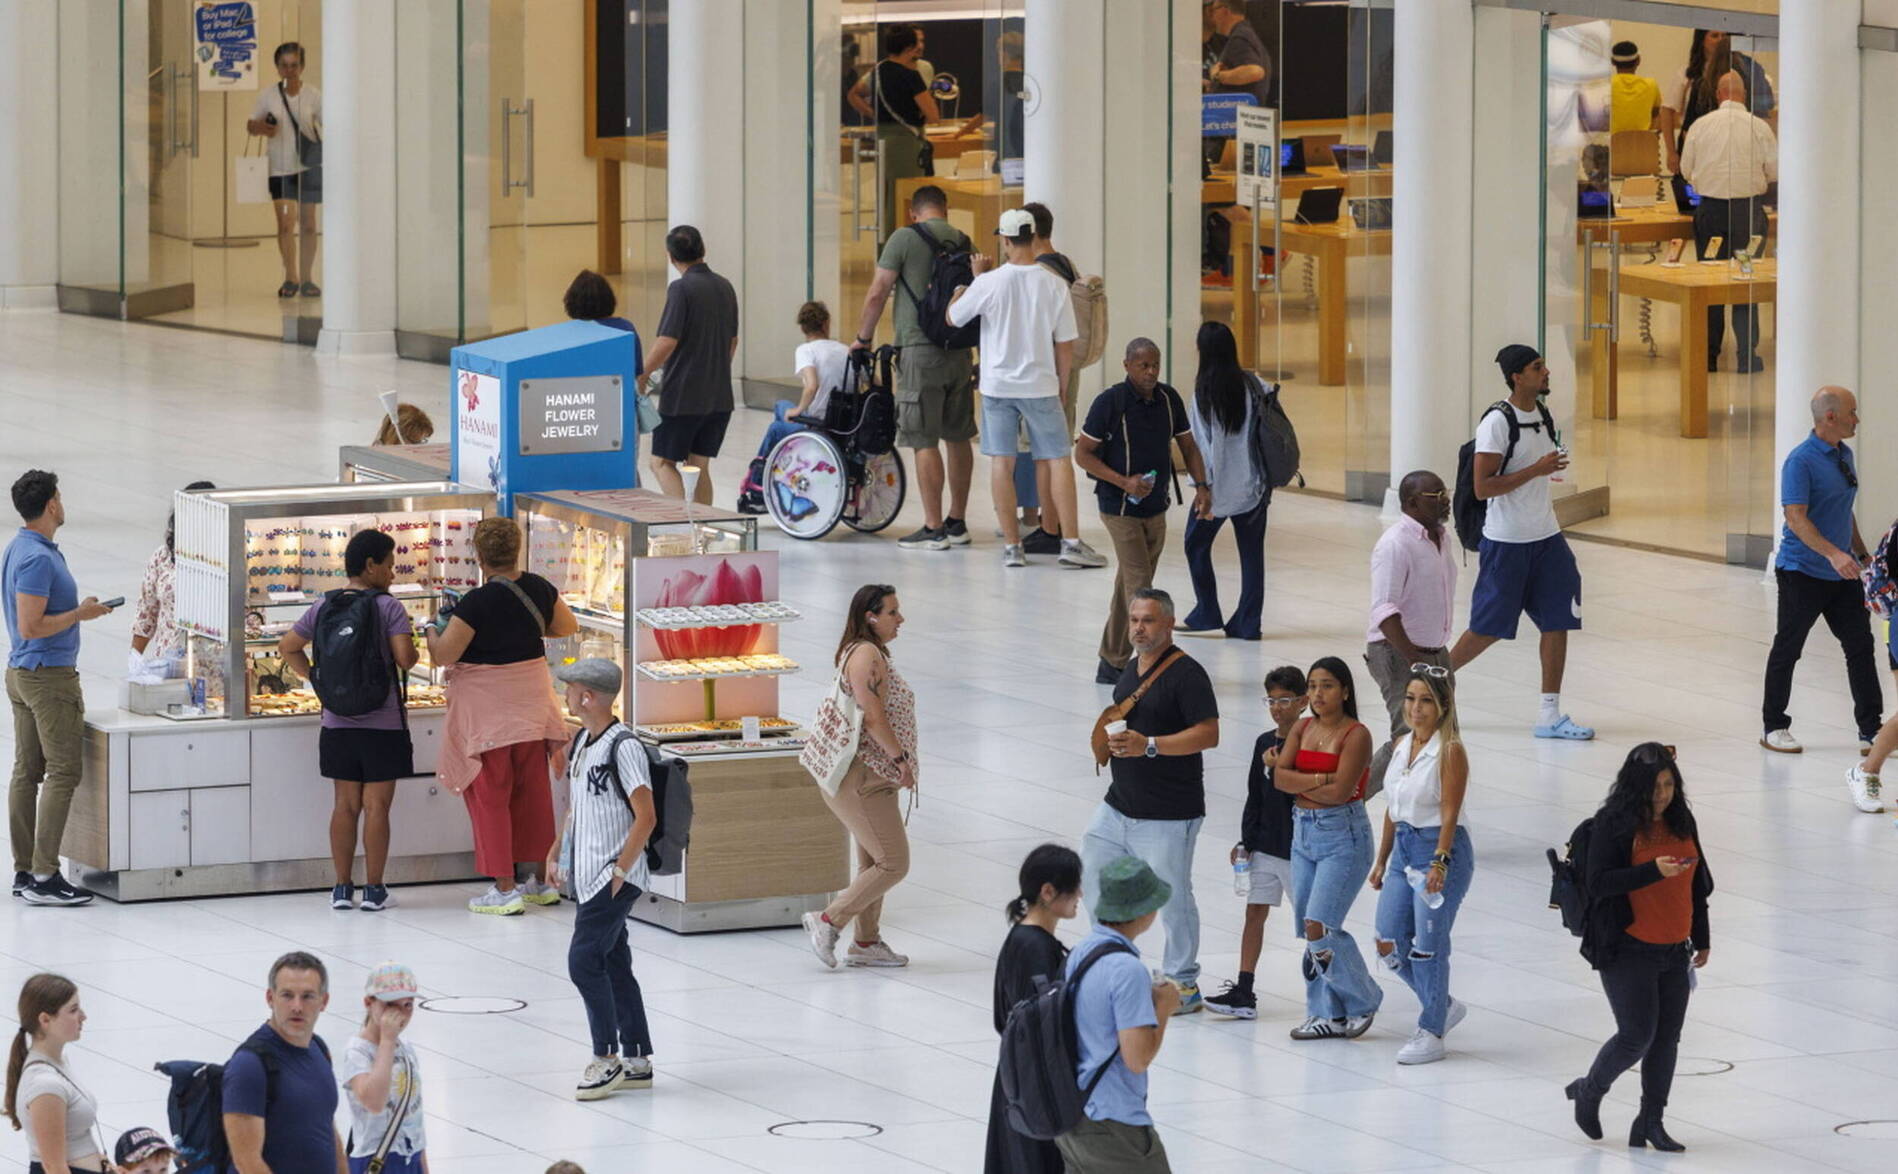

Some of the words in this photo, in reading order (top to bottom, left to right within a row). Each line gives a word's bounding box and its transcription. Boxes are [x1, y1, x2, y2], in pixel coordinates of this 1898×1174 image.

[545, 393, 595, 406] HANAMI
[545, 409, 596, 422] FLOWER
[460, 414, 498, 438] HANAMI
[541, 424, 599, 438] JEWELRY
